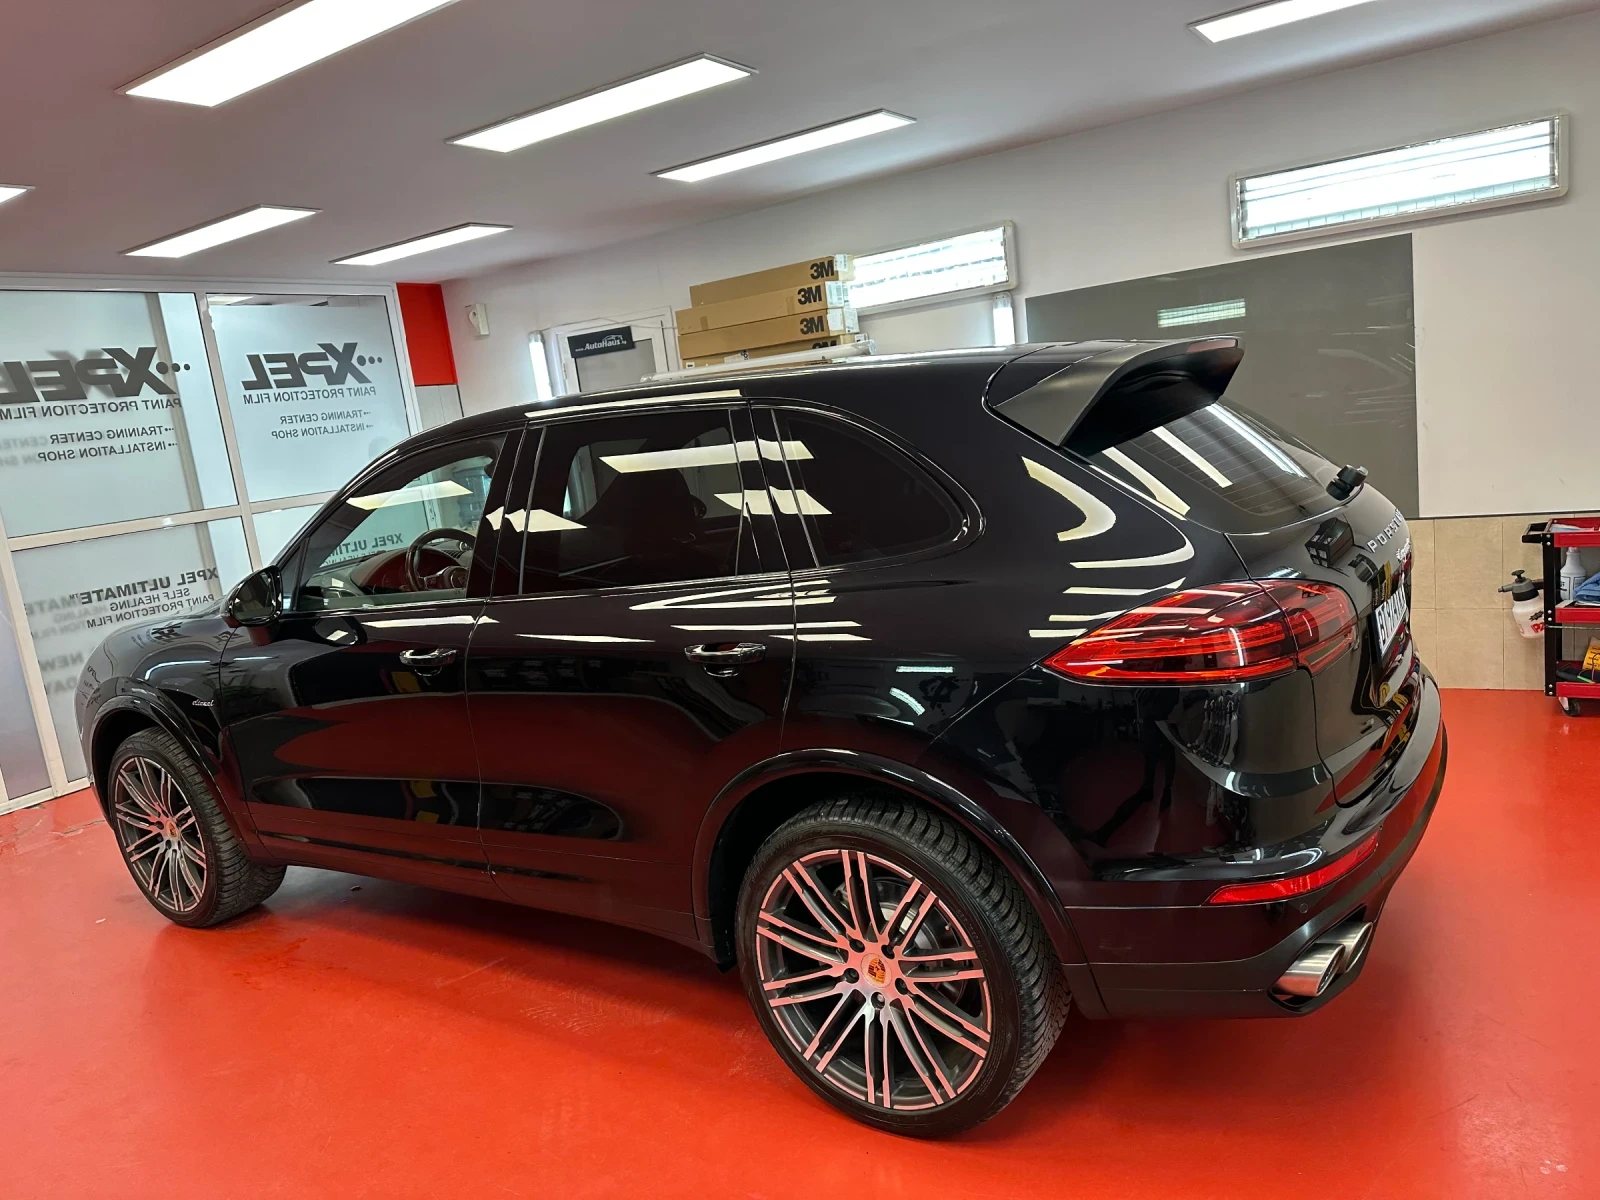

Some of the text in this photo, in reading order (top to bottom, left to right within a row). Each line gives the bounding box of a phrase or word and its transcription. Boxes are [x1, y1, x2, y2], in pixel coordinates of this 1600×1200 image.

[810, 259, 835, 280] 3M
[797, 284, 823, 306] 3M
[800, 315, 825, 335] 3M
